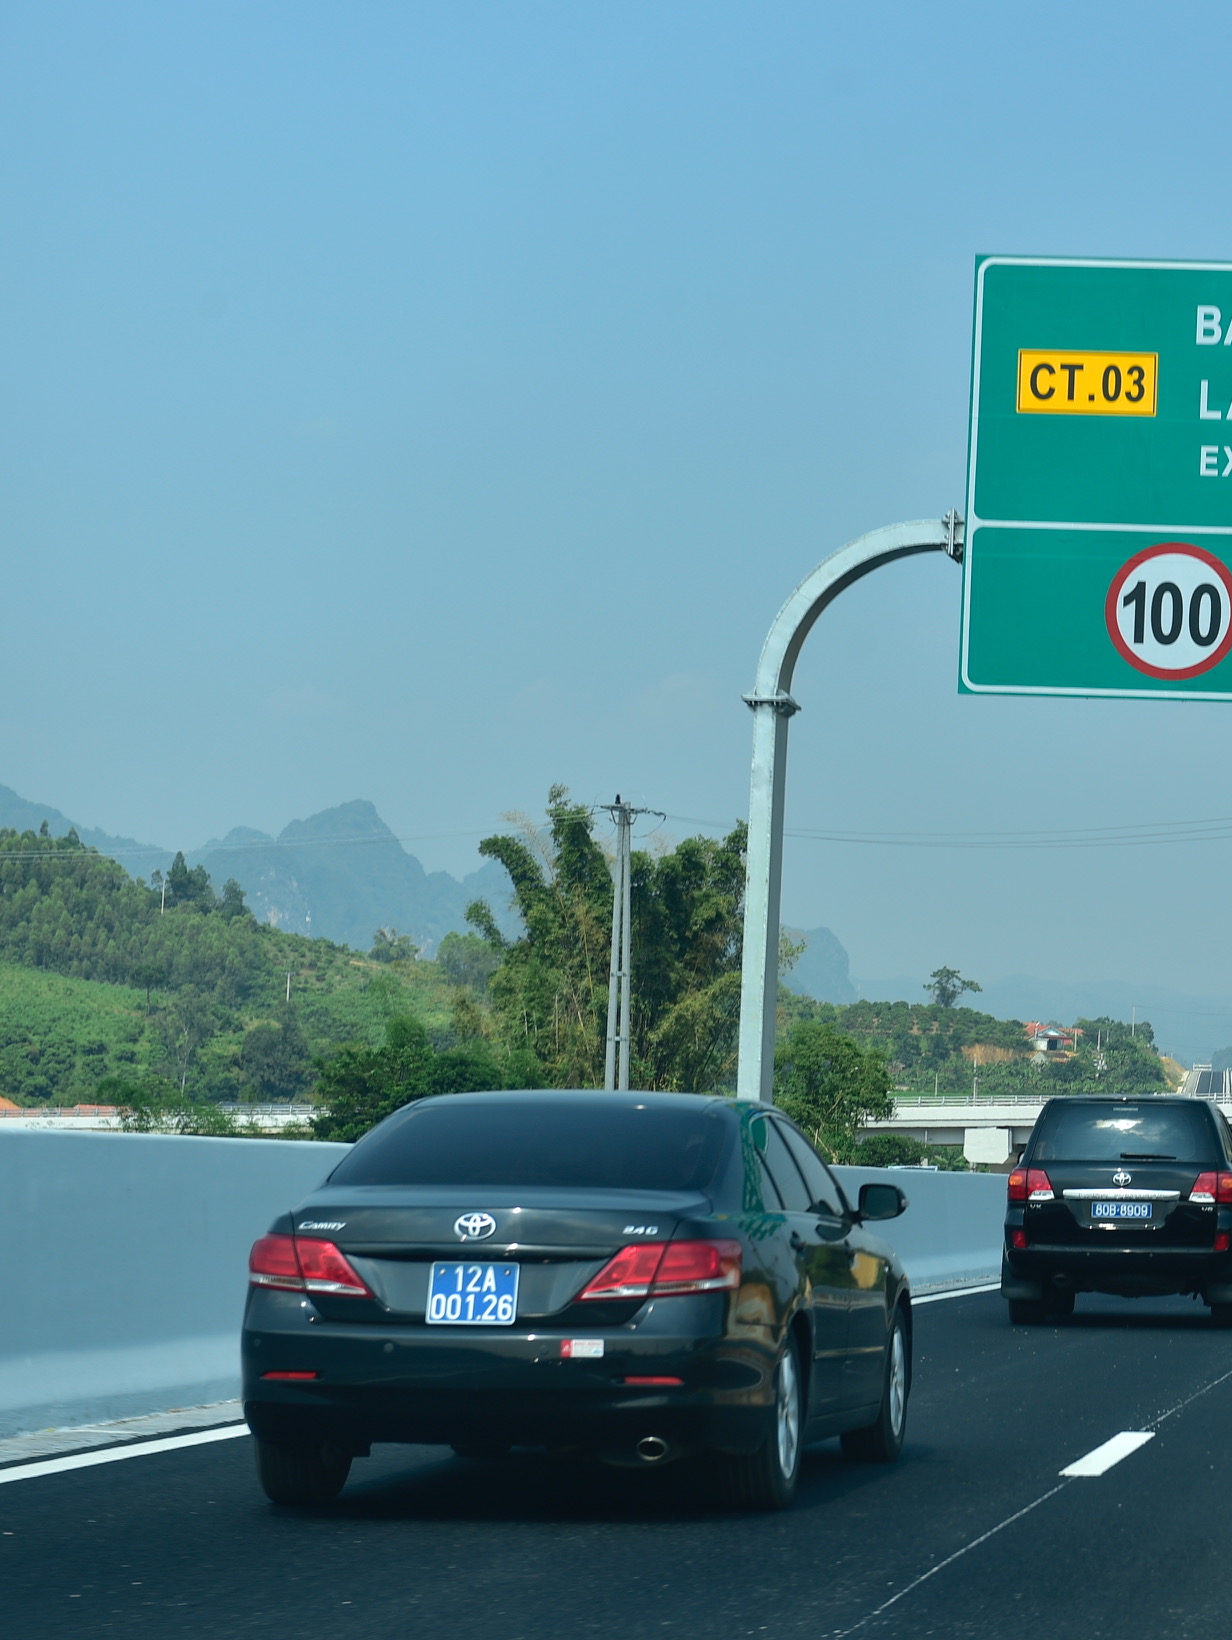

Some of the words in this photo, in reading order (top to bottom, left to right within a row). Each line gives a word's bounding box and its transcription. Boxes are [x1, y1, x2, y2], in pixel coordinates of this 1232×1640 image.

[1030, 364, 1144, 402] CT.03
[1122, 580, 1222, 647] 100
[454, 1265, 496, 1292] 12A
[431, 1293, 513, 1320] 001.26
